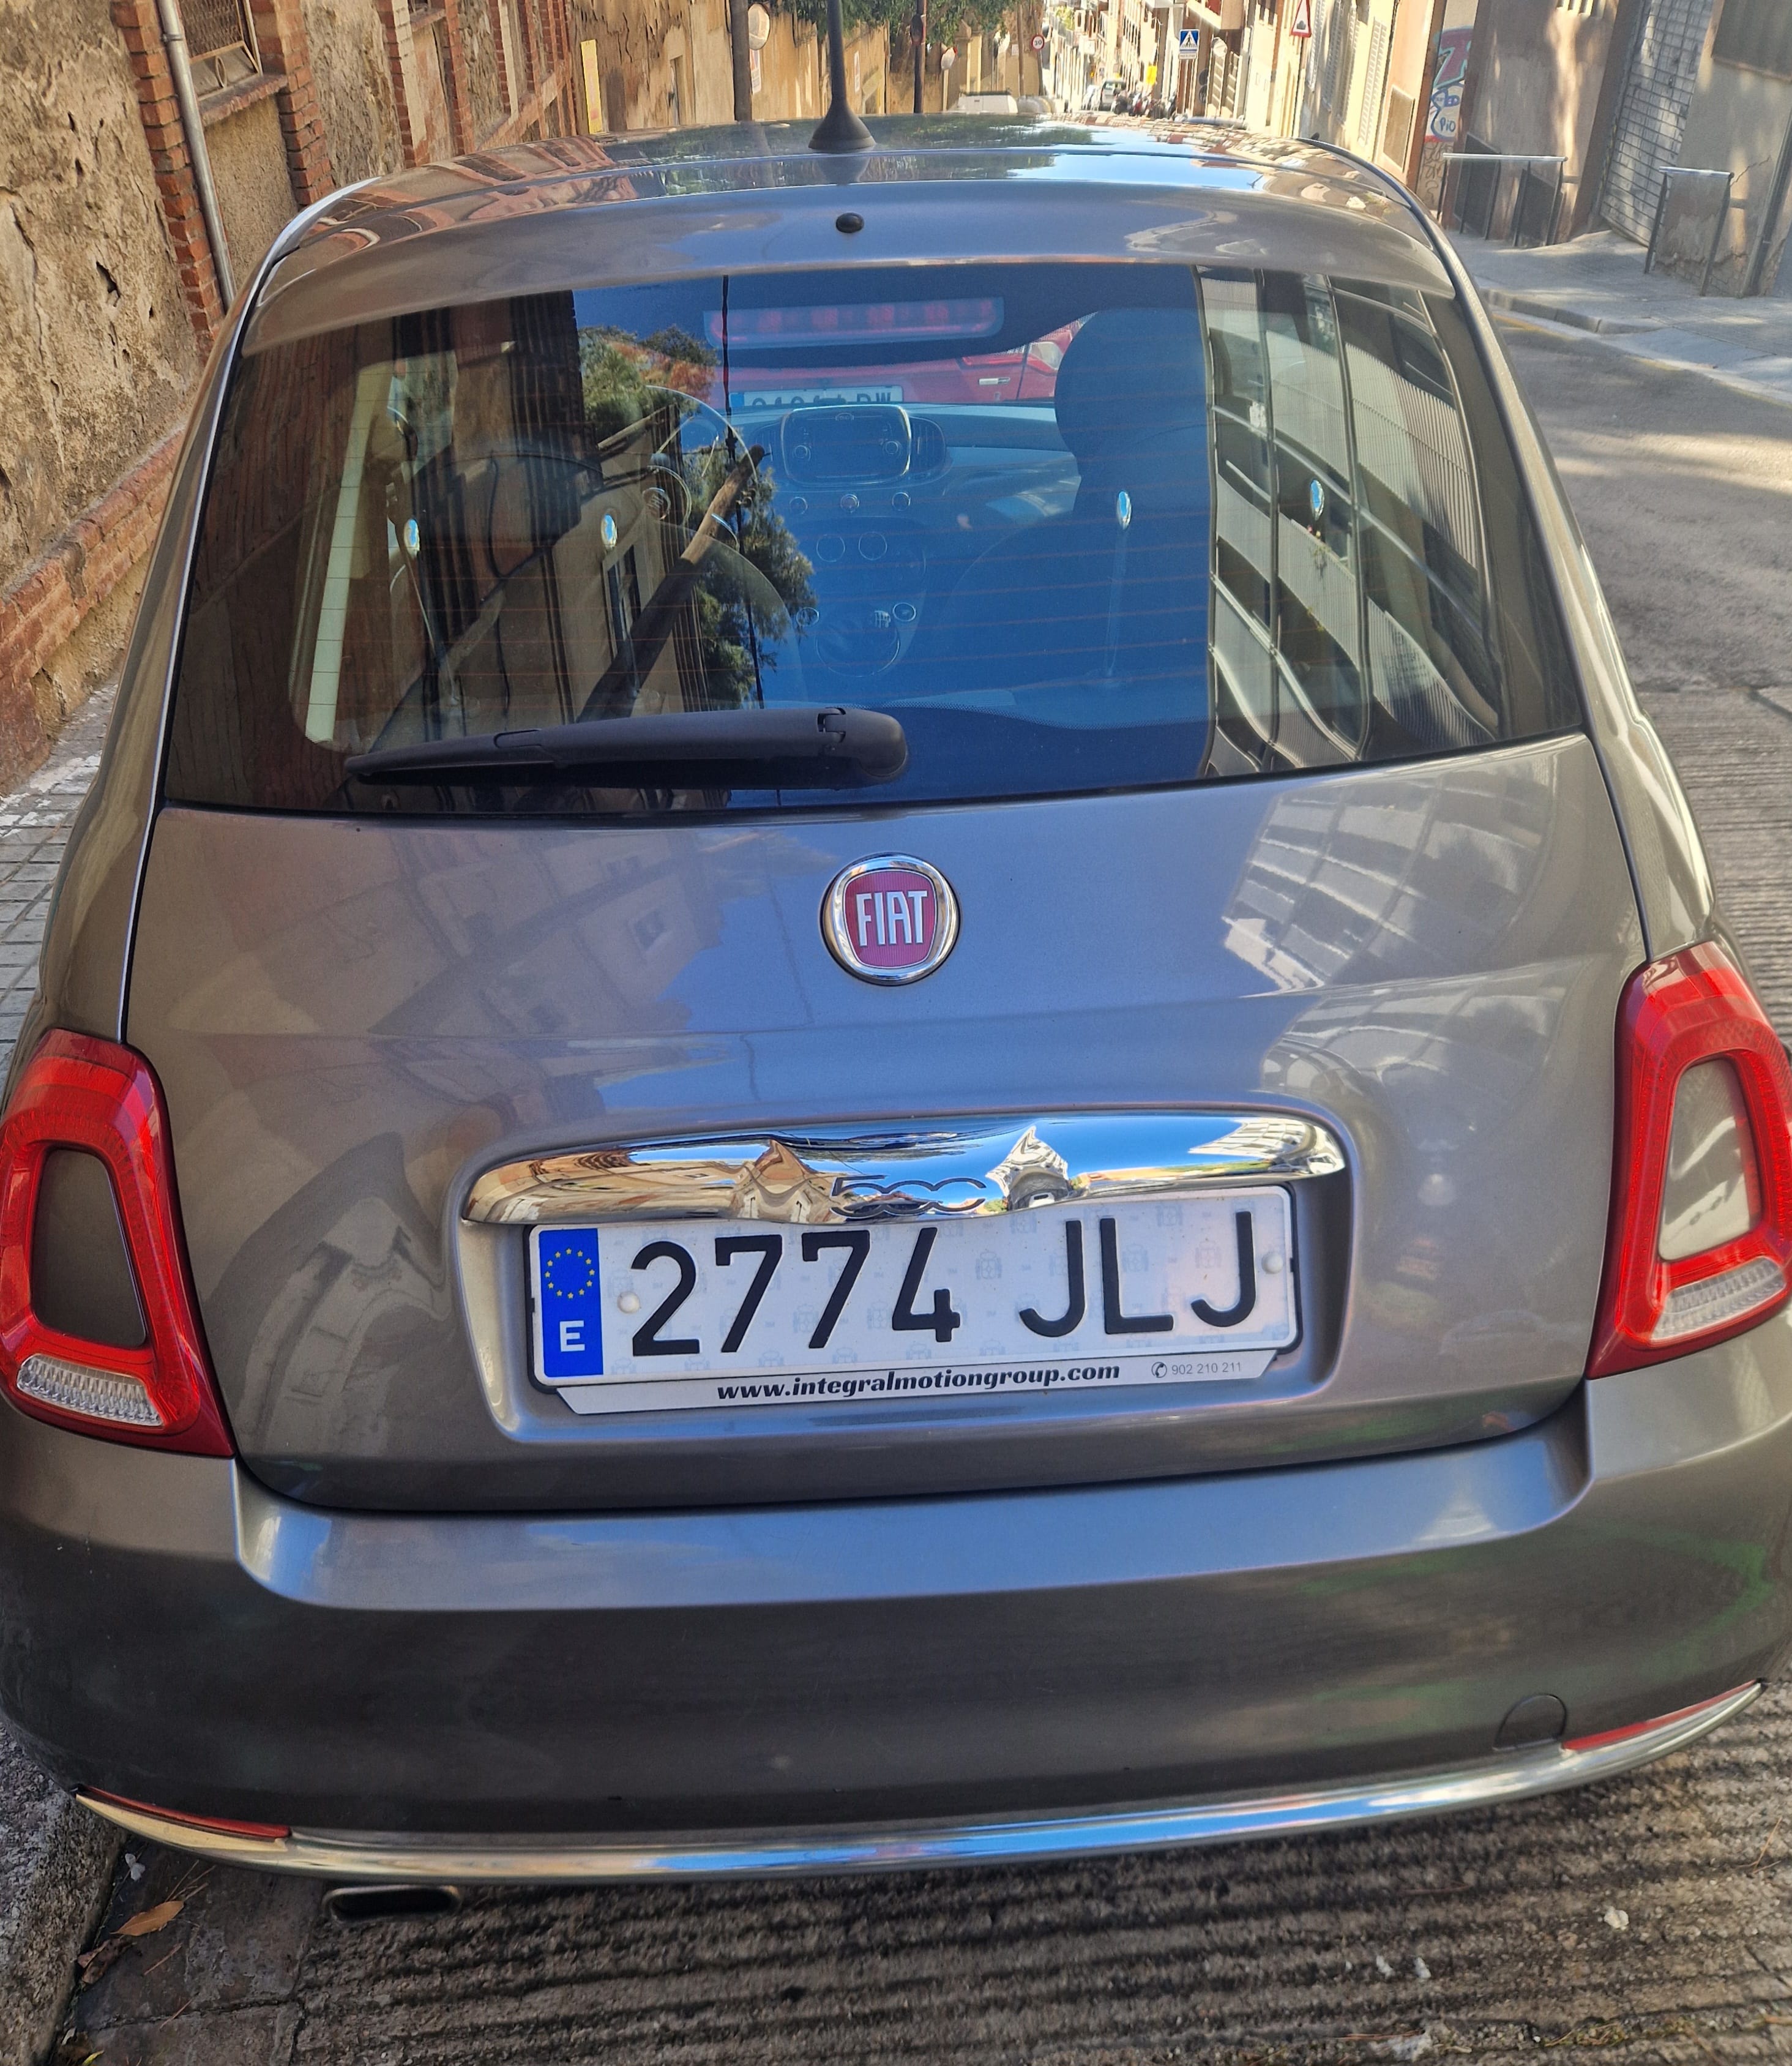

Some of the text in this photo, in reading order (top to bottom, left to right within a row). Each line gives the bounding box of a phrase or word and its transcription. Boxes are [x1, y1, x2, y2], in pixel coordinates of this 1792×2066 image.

[856, 890, 928, 946] FIAT
[829, 1174, 987, 1219] 500
[630, 1211, 1256, 1357] 2774 JLJ
[559, 1320, 586, 1352] E
[717, 1364, 1120, 1400] www.integralmotiongroup.com
[1171, 1361, 1241, 1375] 902 210 211
